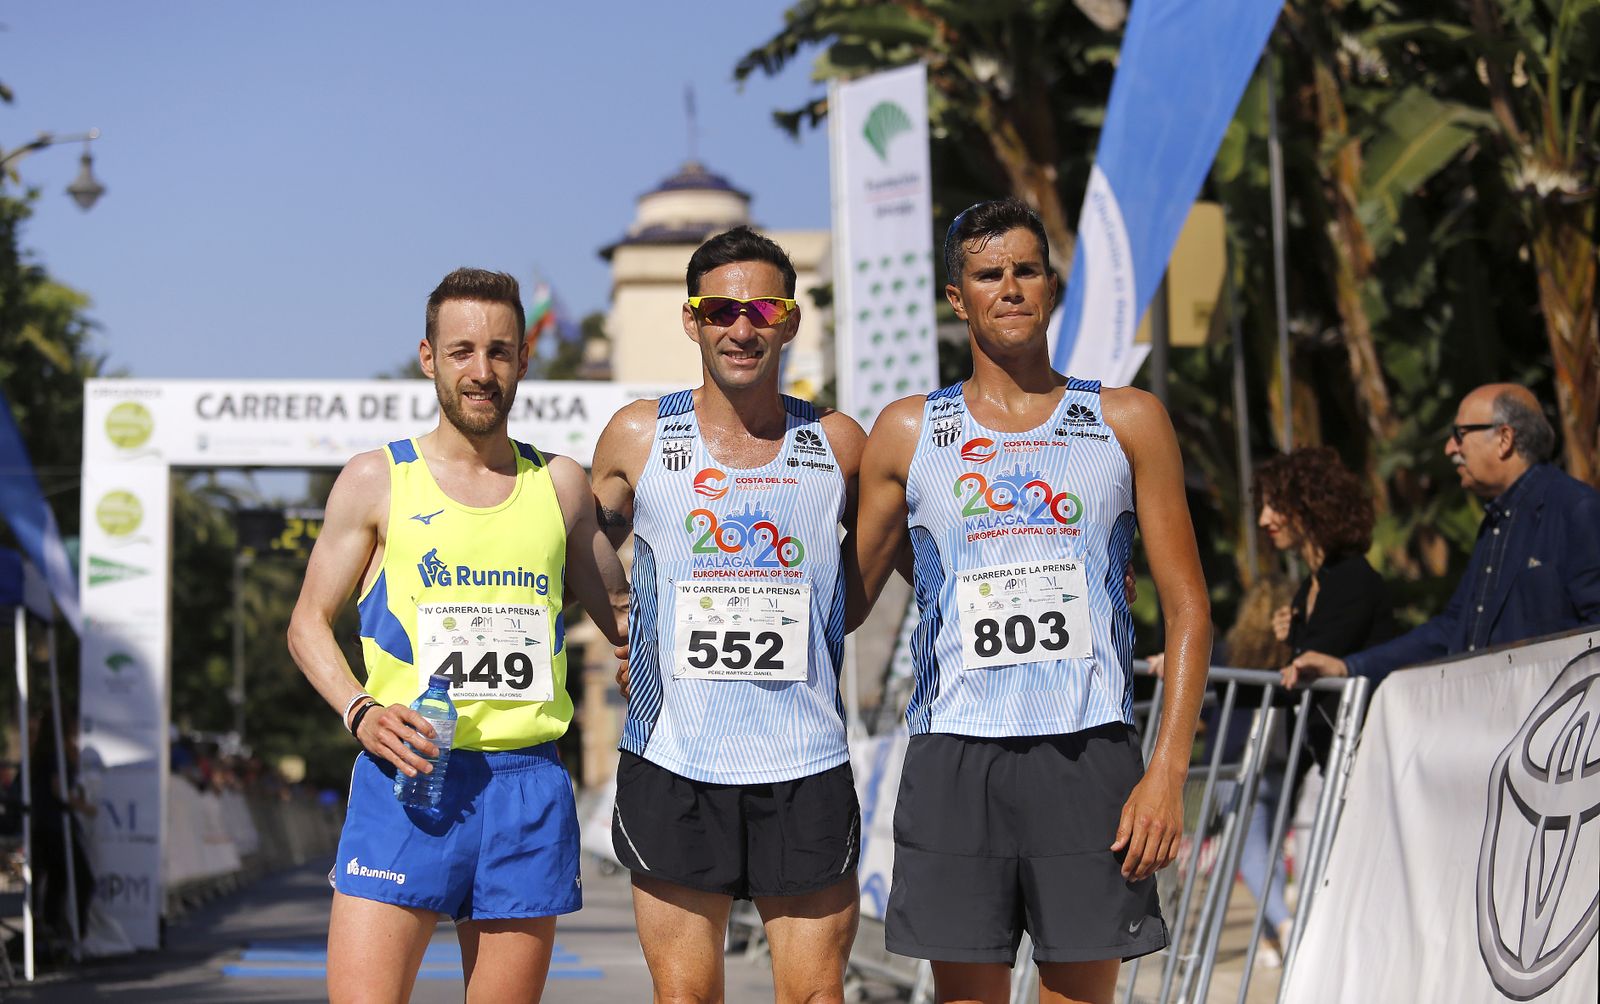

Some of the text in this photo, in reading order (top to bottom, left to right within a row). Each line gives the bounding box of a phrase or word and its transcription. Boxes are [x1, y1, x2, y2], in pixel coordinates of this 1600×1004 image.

[197, 393, 346, 421] CARRERA
[360, 393, 398, 421] DE
[1070, 431, 1110, 439] cajamar
[801, 460, 834, 470] cajamar
[954, 472, 1083, 525] 2020
[685, 508, 805, 568] 2020
[967, 529, 1009, 542] EUROPEAN
[1060, 528, 1081, 536] SPORT
[693, 554, 752, 568] MÁLAGA
[456, 566, 549, 596] Running
[693, 570, 736, 578] EUROPEAN
[972, 569, 1012, 582] CARRERA
[1014, 567, 1027, 575] DE
[1029, 566, 1040, 574] LA
[1042, 563, 1077, 573] PRENSA
[435, 606, 480, 614] CARRERA
[507, 607, 540, 616] PRENSA
[727, 596, 750, 607] APM
[470, 616, 493, 627] APM
[974, 611, 1070, 658] 803
[687, 630, 784, 670] 552
[433, 651, 534, 690] 449
[360, 866, 406, 885] Running
